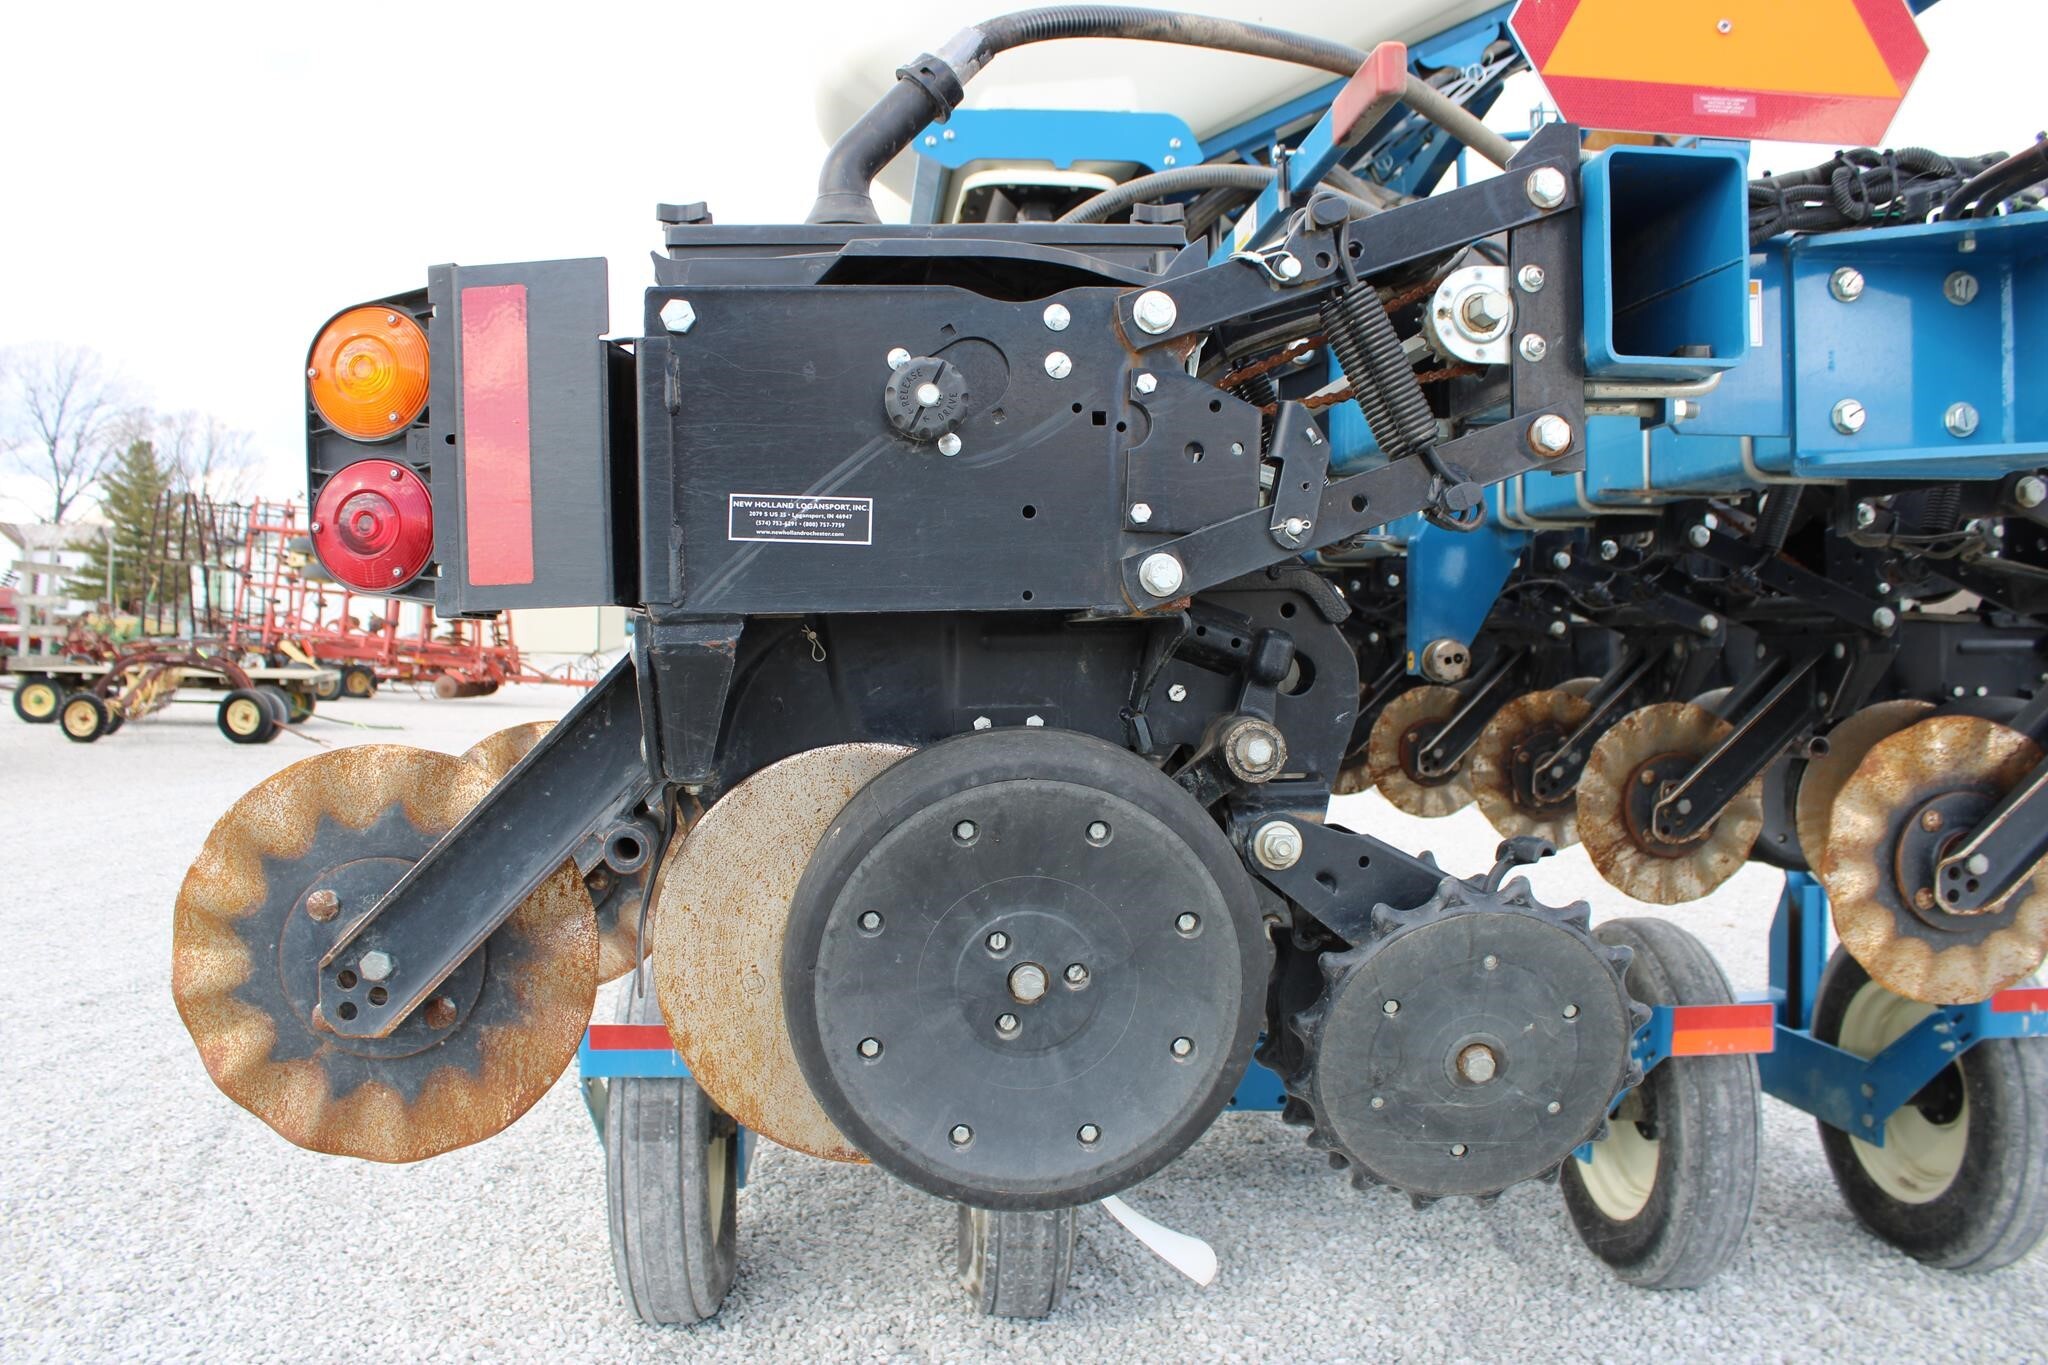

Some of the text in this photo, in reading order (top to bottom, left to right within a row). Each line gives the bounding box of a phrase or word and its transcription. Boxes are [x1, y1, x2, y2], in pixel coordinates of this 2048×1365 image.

[900, 368, 924, 407] RELEASE
[937, 392, 958, 421] DRIVE
[733, 500, 753, 508] NEW
[754, 501, 794, 509] HOLLAND
[796, 502, 851, 511] LOGANSPORT,
[756, 529, 844, 537] www.newhollandrochester.com
